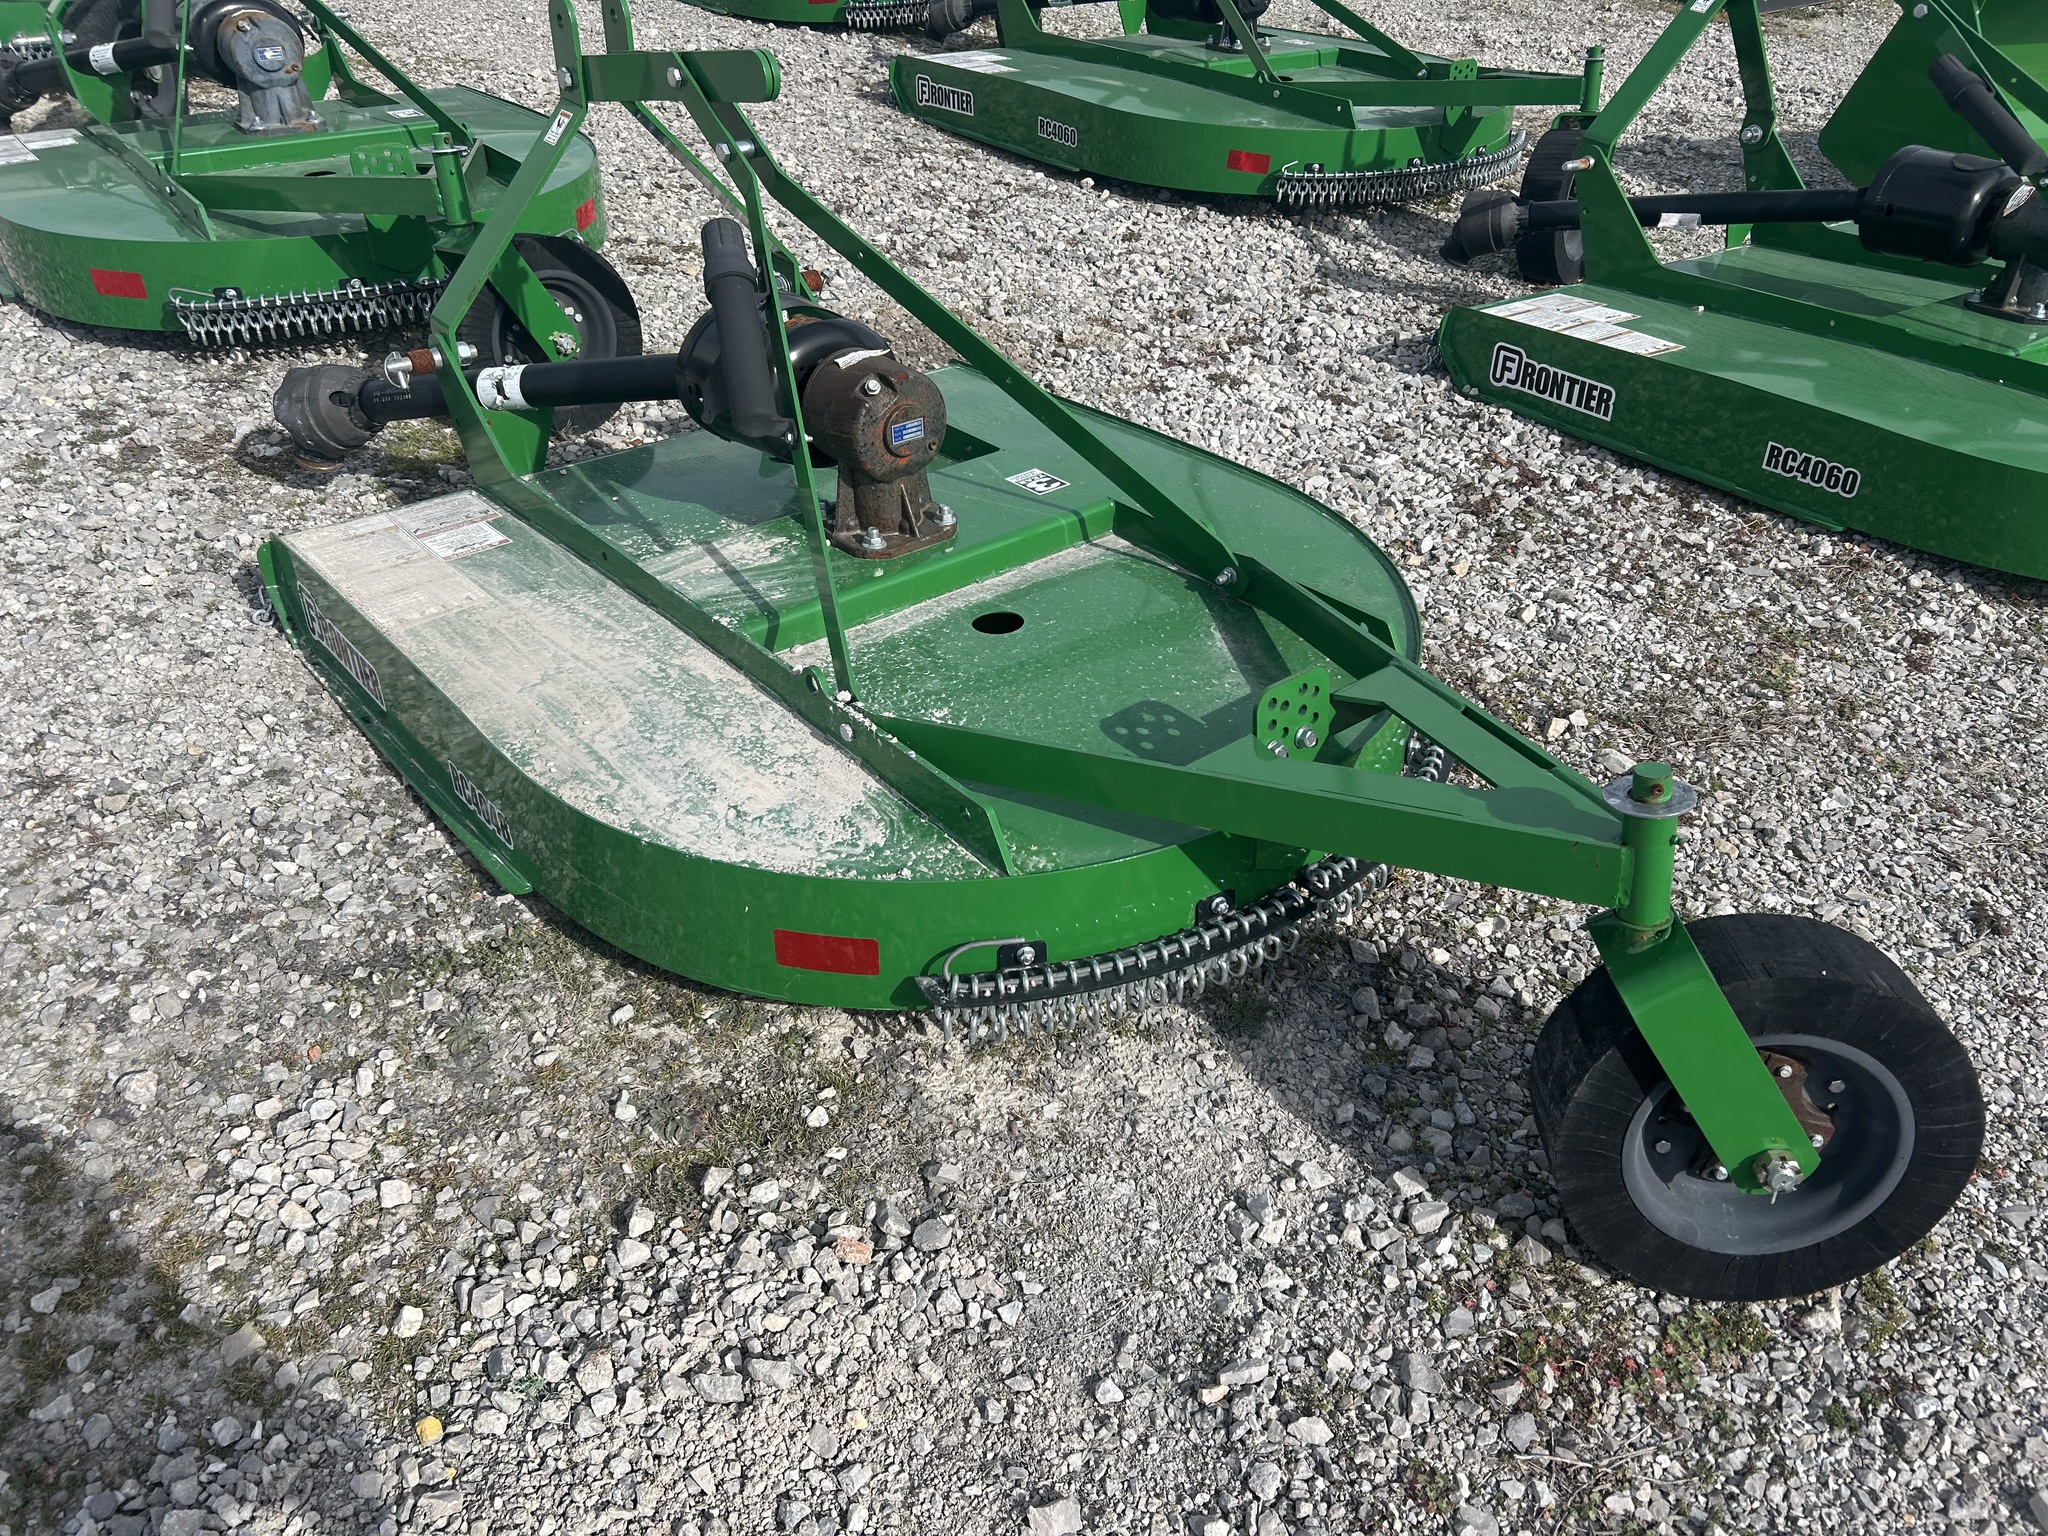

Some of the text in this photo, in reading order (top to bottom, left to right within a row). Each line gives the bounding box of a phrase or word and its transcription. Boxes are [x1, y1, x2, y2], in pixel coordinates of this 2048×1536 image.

[917, 76, 973, 114] FRONTIER
[1039, 118, 1076, 146] RC4060
[1492, 344, 1613, 418] FRONTIER
[1765, 444, 1859, 495] RC4060
[298, 581, 385, 708] FRONTIER
[447, 761, 514, 848] RC4048
